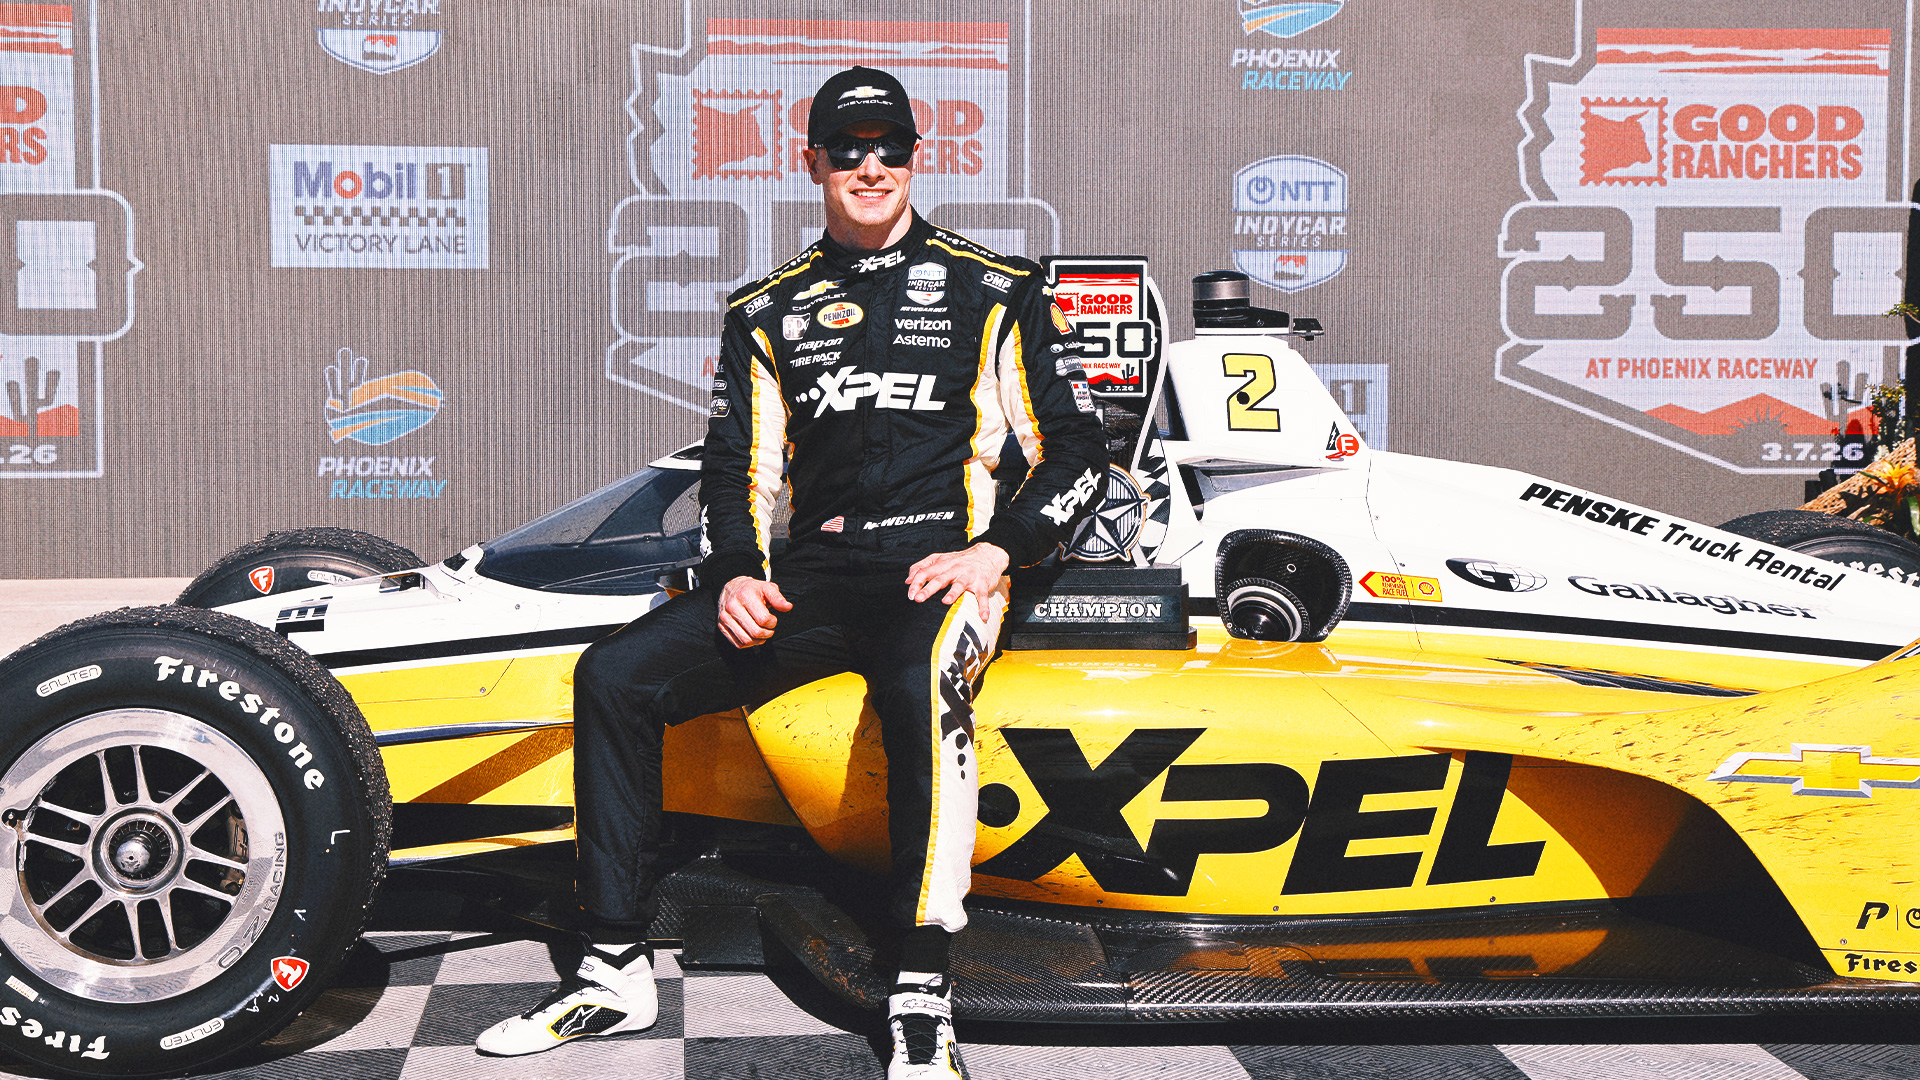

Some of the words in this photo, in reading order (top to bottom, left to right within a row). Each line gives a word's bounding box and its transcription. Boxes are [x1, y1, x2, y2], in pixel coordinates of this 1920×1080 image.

[342, 13, 413, 26] SERIES
[1231, 48, 1340, 69] PHOENIX
[1242, 70, 1352, 90] RACEWAY
[837, 99, 893, 110] CHEVROLET
[1672, 104, 1864, 142] GOOD
[1672, 144, 1863, 180] RANCHERS
[294, 161, 416, 199] Mobil
[1280, 180, 1336, 202] NTT
[1234, 215, 1347, 235] INDYCAR
[295, 234, 398, 253] VICTORY
[405, 235, 465, 254] LANE
[1256, 236, 1321, 248] SERIES
[859, 250, 906, 273] XPEL
[983, 272, 1012, 290] OMP
[746, 295, 771, 314] OMP
[1080, 294, 1133, 305] GOOD
[824, 307, 857, 323] PENNZOIL
[1080, 305, 1133, 315] RANCHERS
[895, 317, 951, 331] verizon
[893, 334, 951, 348] Astemo
[790, 355, 812, 368] TIRE
[812, 351, 842, 364] RACK
[1093, 362, 1121, 370] RACEWAY
[1585, 358, 1613, 379] AT
[1618, 358, 1711, 379] PHOENIX
[1717, 358, 1818, 379] RACEWAY
[814, 366, 947, 419] XPEL
[1222, 353, 1281, 432] 2
[1761, 442, 1864, 461] 3.7.26
[318, 456, 436, 476] PHOENIX
[330, 479, 447, 499] RACEWAY
[863, 511, 955, 530] NWGARDEN
[1519, 482, 1660, 536] PENSKE
[1661, 523, 1743, 562] Truck
[1745, 549, 1846, 592] Rental
[1381, 575, 1407, 584] 100%
[1382, 588, 1396, 596] RACE
[1567, 575, 1817, 619] Gallagher
[1033, 602, 1163, 619] CHAMPION
[39, 667, 99, 695] ENLITEN
[154, 655, 325, 790] Firestone
[970, 727, 1547, 897] XPEL
[1845, 953, 1918, 975] Fires
[162, 1020, 222, 1048] ENLITEN
